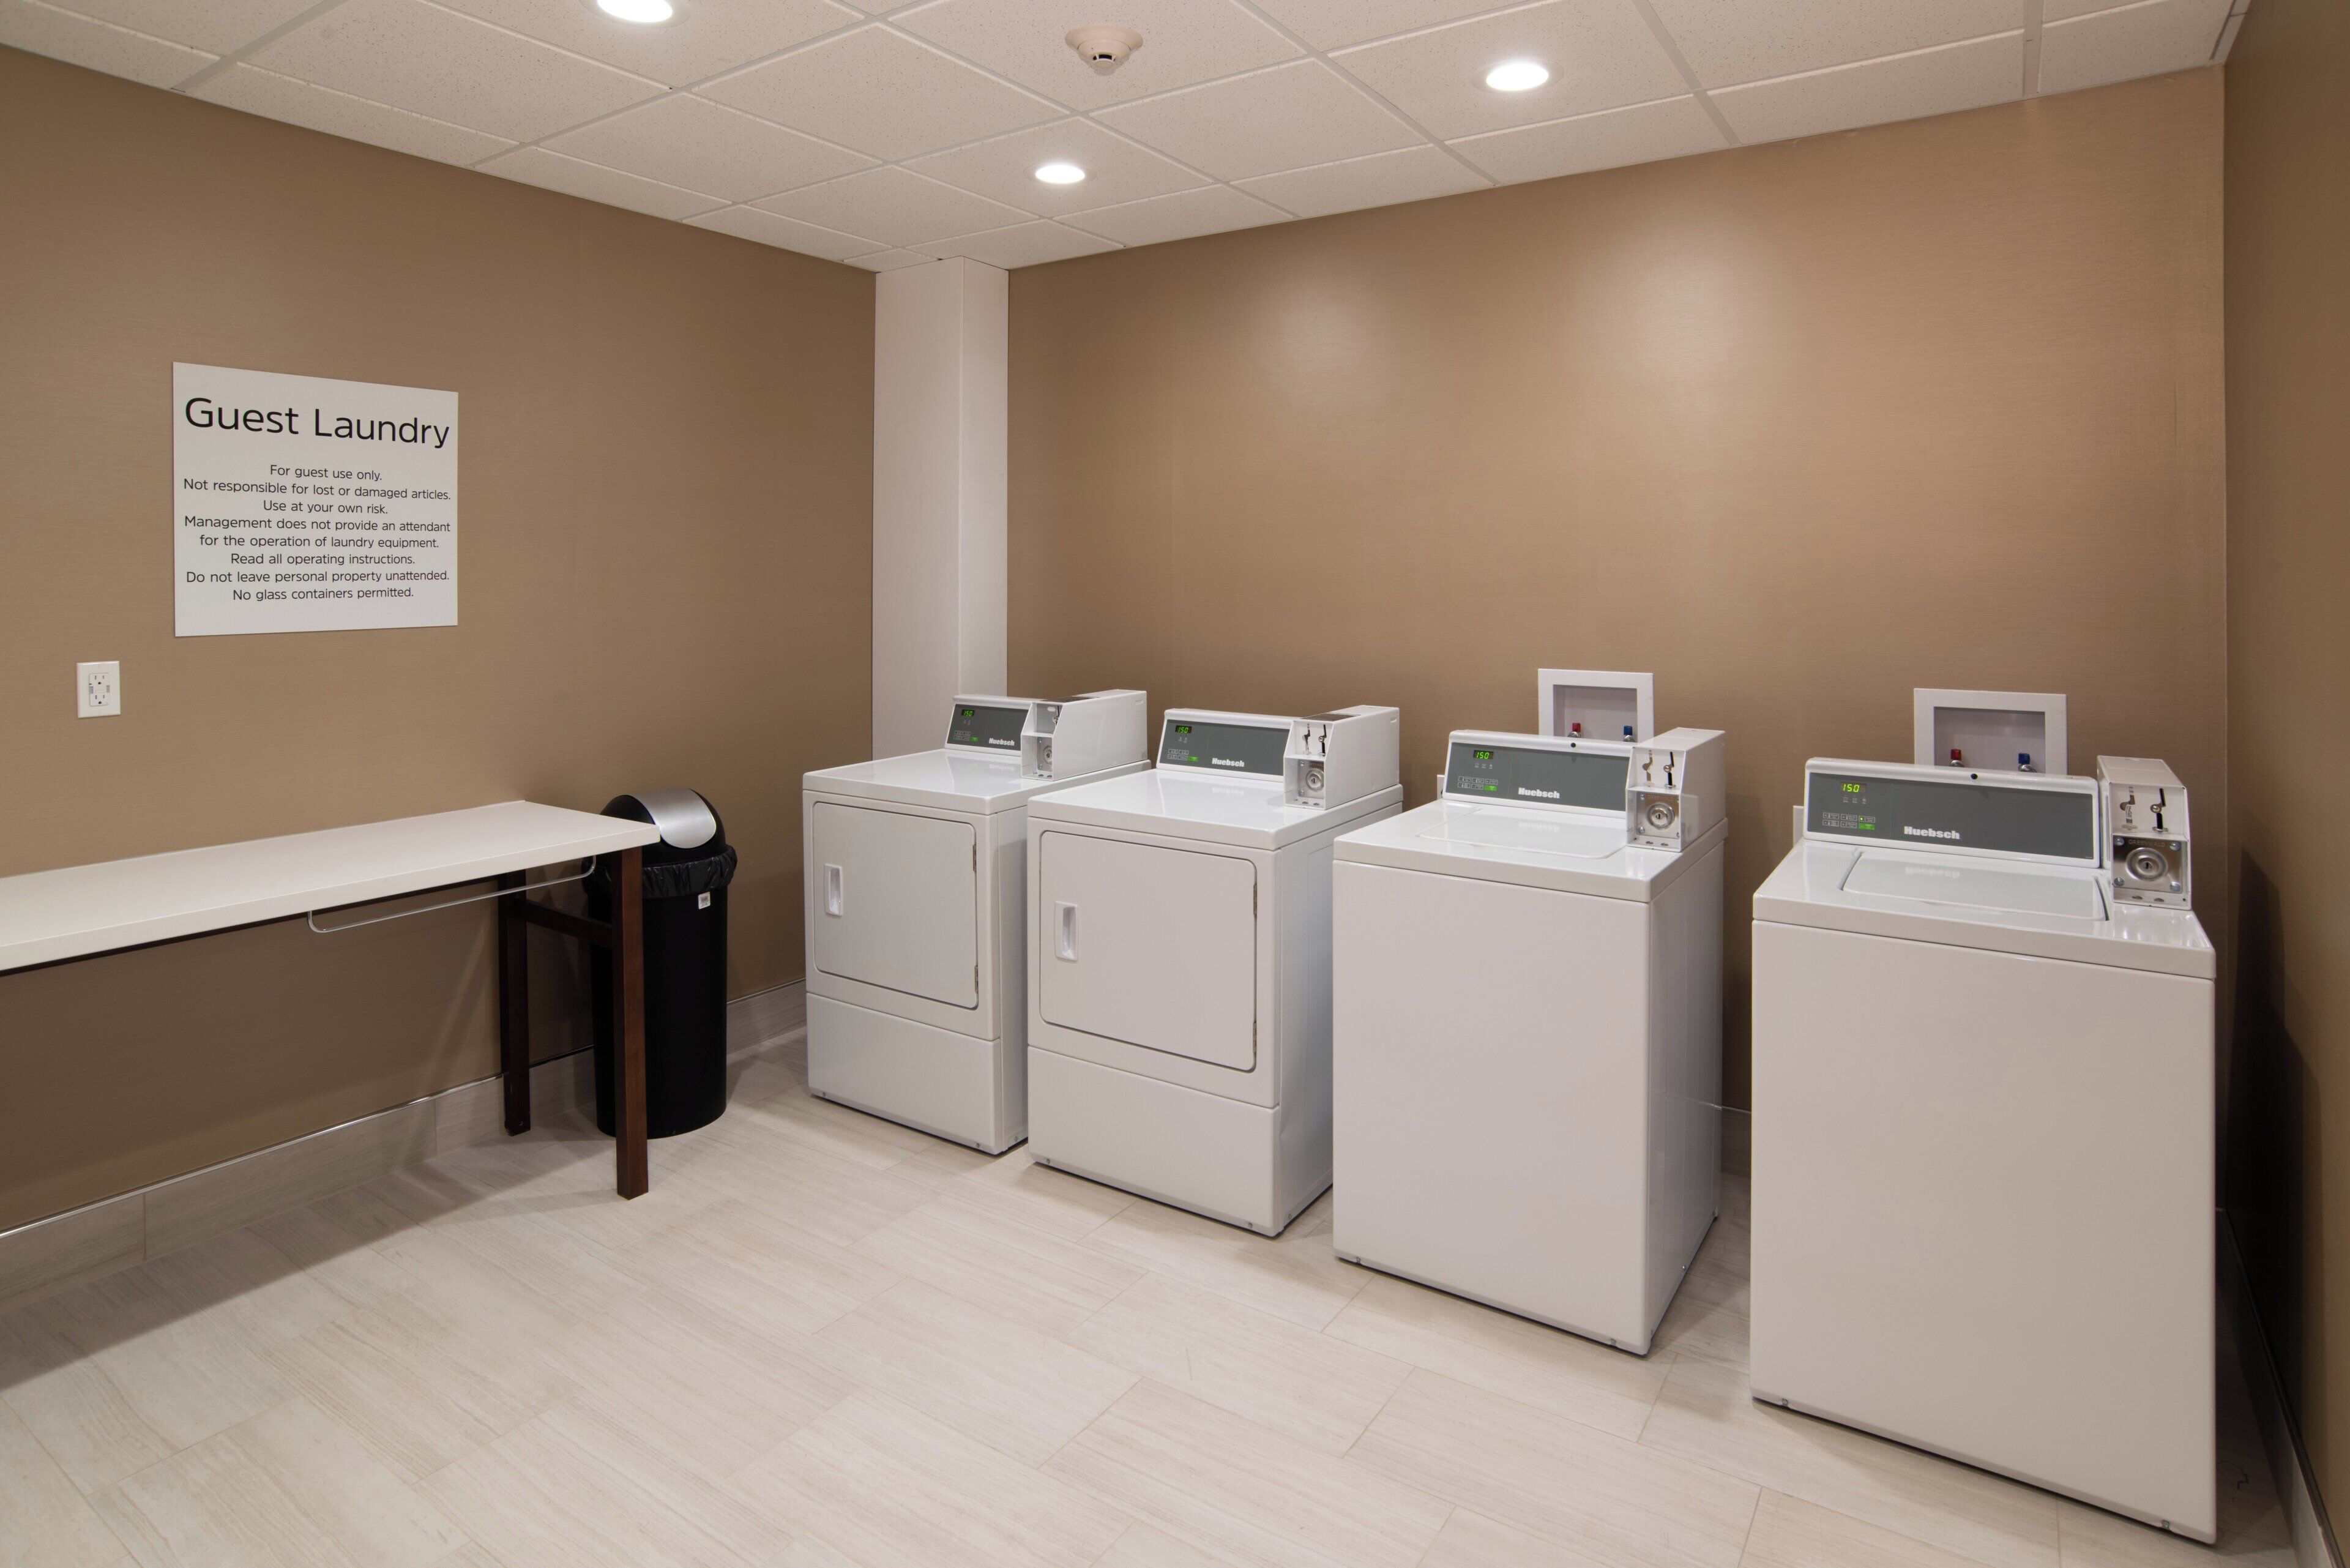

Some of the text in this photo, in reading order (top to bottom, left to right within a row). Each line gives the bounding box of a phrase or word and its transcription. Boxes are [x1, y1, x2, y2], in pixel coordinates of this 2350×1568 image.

[185, 397, 450, 449] Guest Laundry
[270, 464, 382, 482] For guest use only.
[184, 478, 451, 500] Not responsible for lost or damaged articles.
[263, 499, 388, 514] Use at your own risk.
[185, 515, 272, 529] Management
[277, 518, 307, 529] does
[311, 520, 331, 530] not
[335, 520, 378, 531] provide
[399, 521, 451, 532] attendant
[200, 534, 439, 549] for the operation of laundry equipment.
[231, 553, 415, 566] Read all operating instructions.
[187, 570, 449, 583] Do not leave personal property unattended.
[233, 587, 414, 602] No glass containers permitted.
[988, 737, 1015, 746] Huebsch
[1212, 757, 1245, 767] Huebsch
[1518, 787, 1561, 799] Huebsch
[1843, 783, 1860, 793] 150
[1903, 826, 1962, 840] Huebsch
